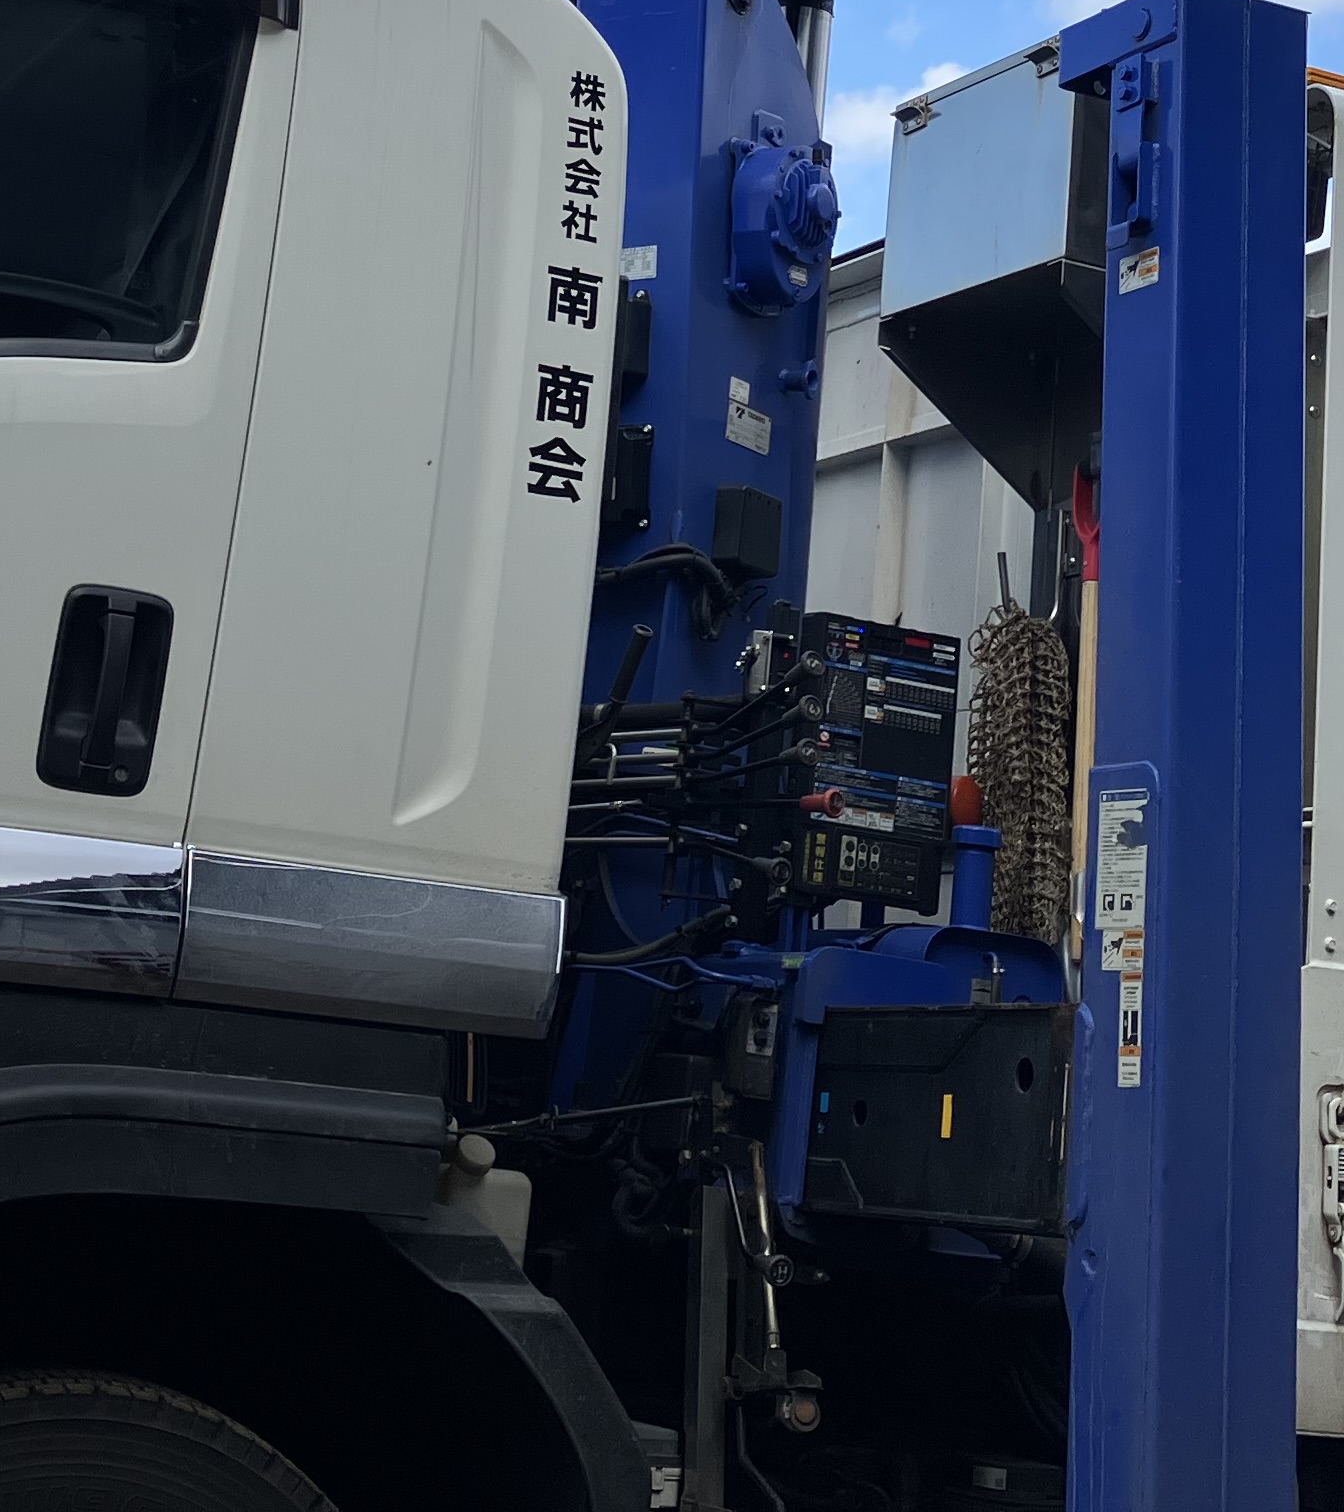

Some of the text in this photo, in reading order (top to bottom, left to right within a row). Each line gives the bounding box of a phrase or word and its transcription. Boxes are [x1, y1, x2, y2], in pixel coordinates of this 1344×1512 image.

[527, 71, 606, 503] 株式会社 南商会
